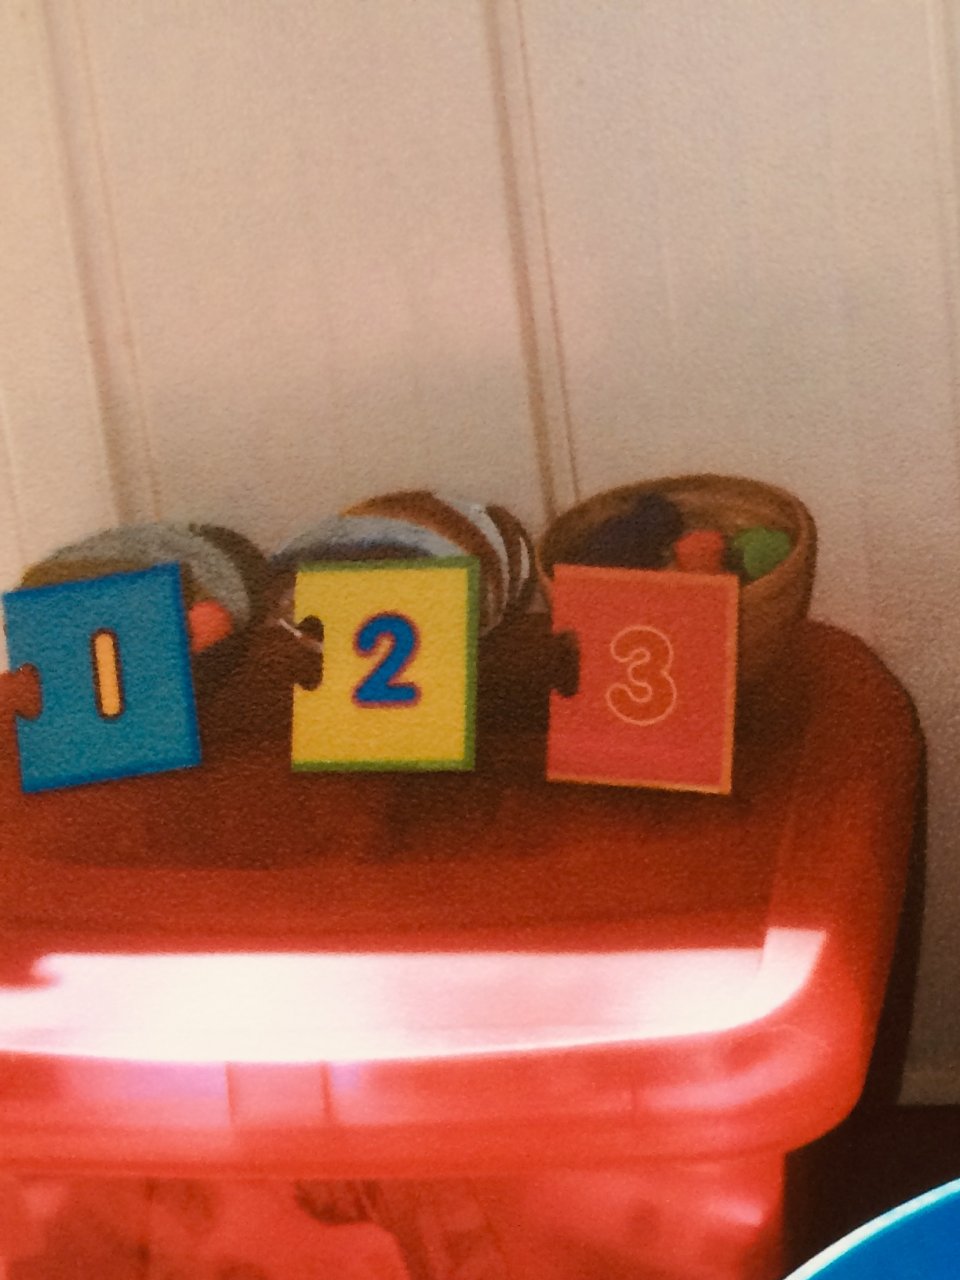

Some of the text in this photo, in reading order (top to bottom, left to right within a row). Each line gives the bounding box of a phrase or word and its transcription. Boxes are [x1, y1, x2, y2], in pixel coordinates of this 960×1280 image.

[92, 629, 126, 718] 1
[352, 612, 421, 709] 2
[606, 625, 677, 726] 3
